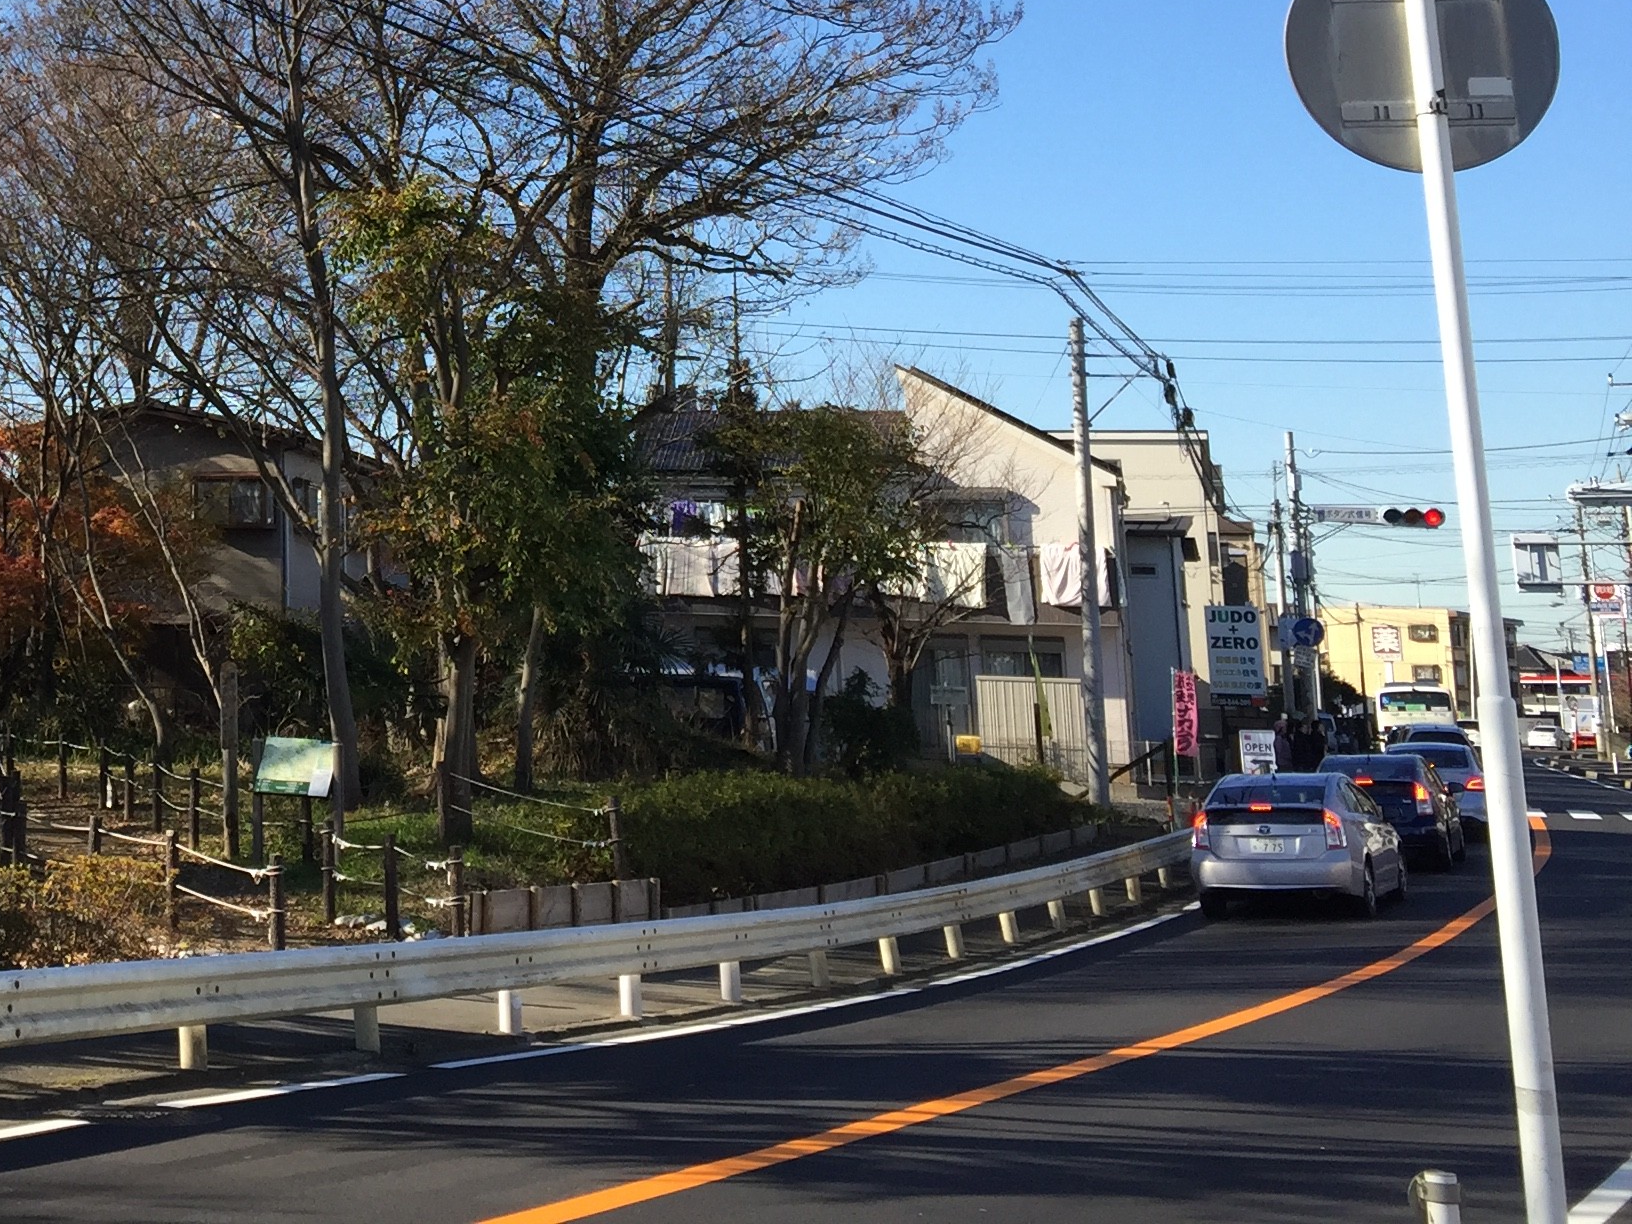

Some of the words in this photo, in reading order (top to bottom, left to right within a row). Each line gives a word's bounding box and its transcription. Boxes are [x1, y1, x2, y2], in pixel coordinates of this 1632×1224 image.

[1209, 610, 1257, 624] JUDO
[1228, 625, 1239, 635] +
[1210, 637, 1259, 650] ZERO
[1372, 627, 1400, 653] 薬
[1244, 742, 1272, 752] OPEN
